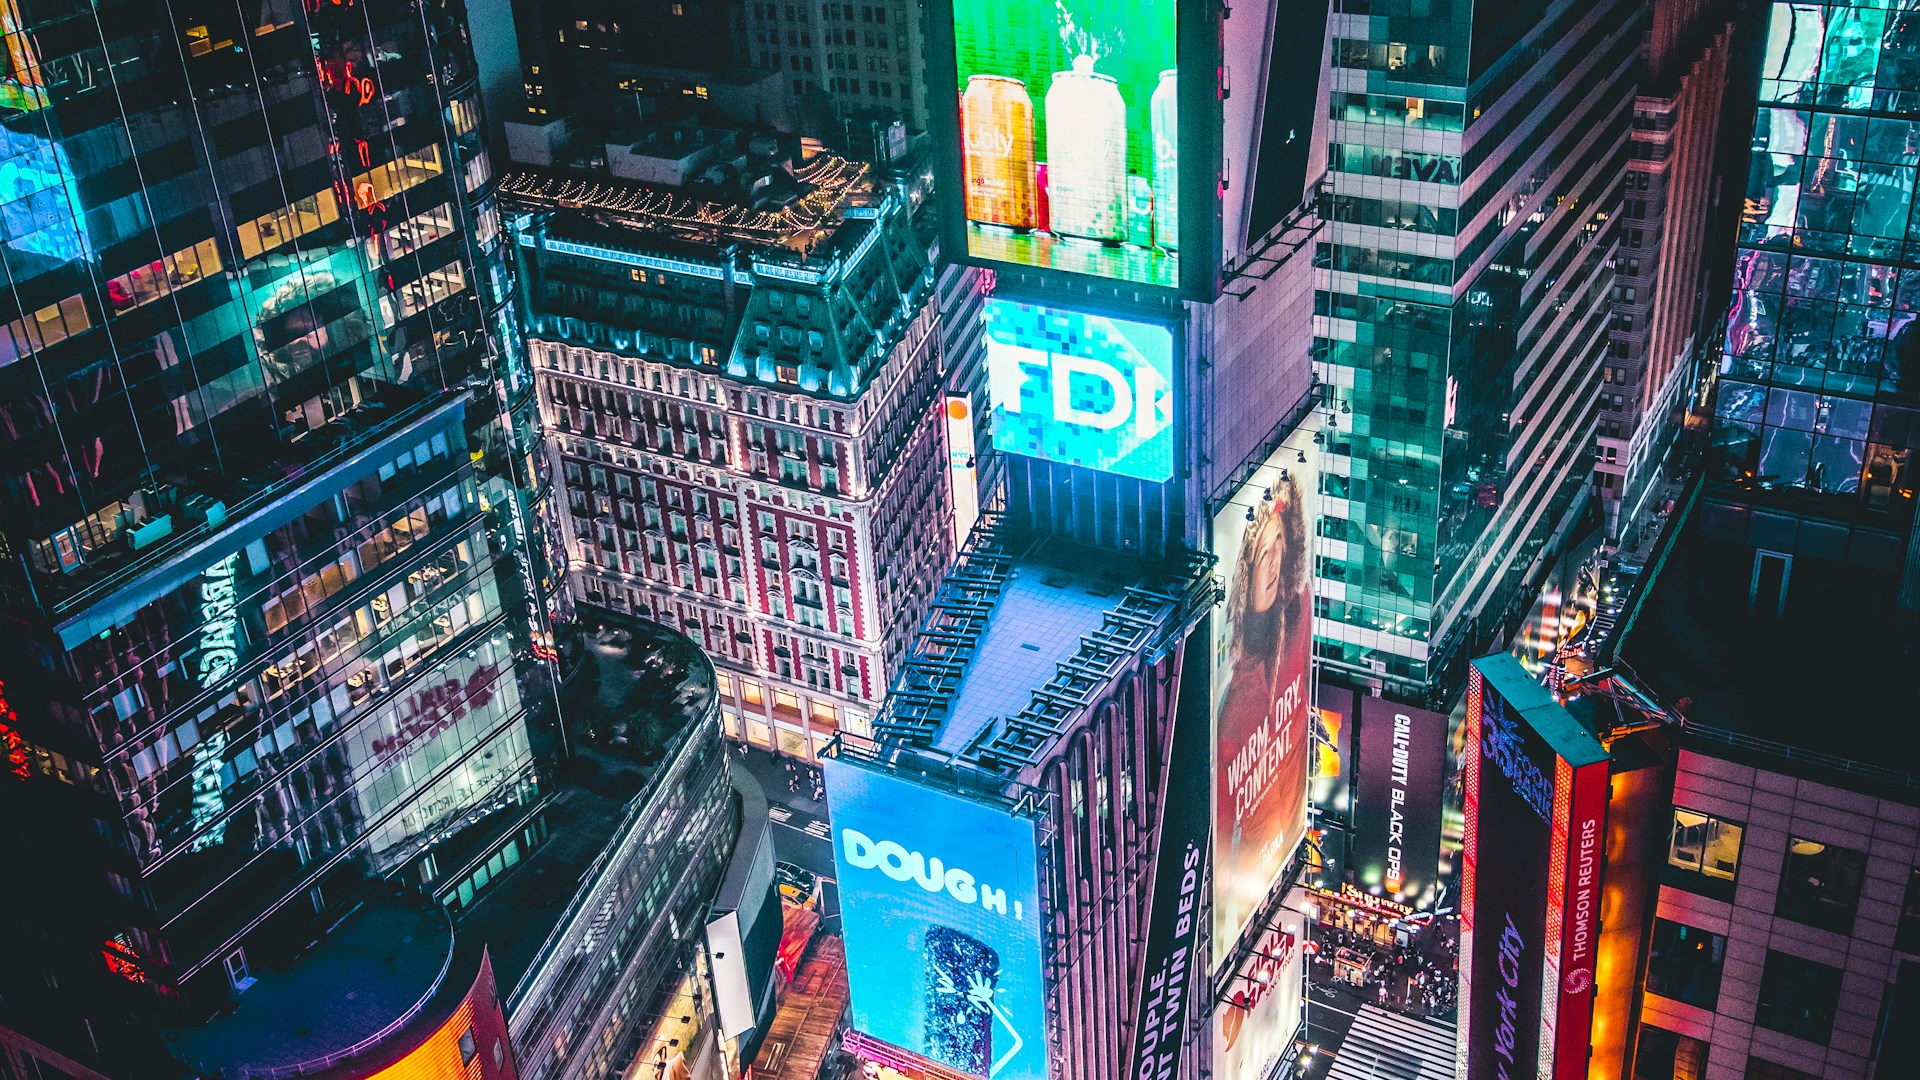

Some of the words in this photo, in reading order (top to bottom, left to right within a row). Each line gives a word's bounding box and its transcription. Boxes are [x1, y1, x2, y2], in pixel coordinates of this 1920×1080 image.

[1227, 715, 1271, 796] WARM.
[1275, 674, 1302, 735] DRY.
[1236, 720, 1293, 822] CONTENT.
[1388, 787, 1405, 846] BLACK
[1577, 818, 1596, 888] REUTERS
[1386, 846, 1402, 881] OPS
[1497, 912, 1525, 989] City
[1573, 888, 1590, 962] THOMSON
[1161, 946, 1187, 1043] TWIN
[1494, 986, 1518, 1065] York
